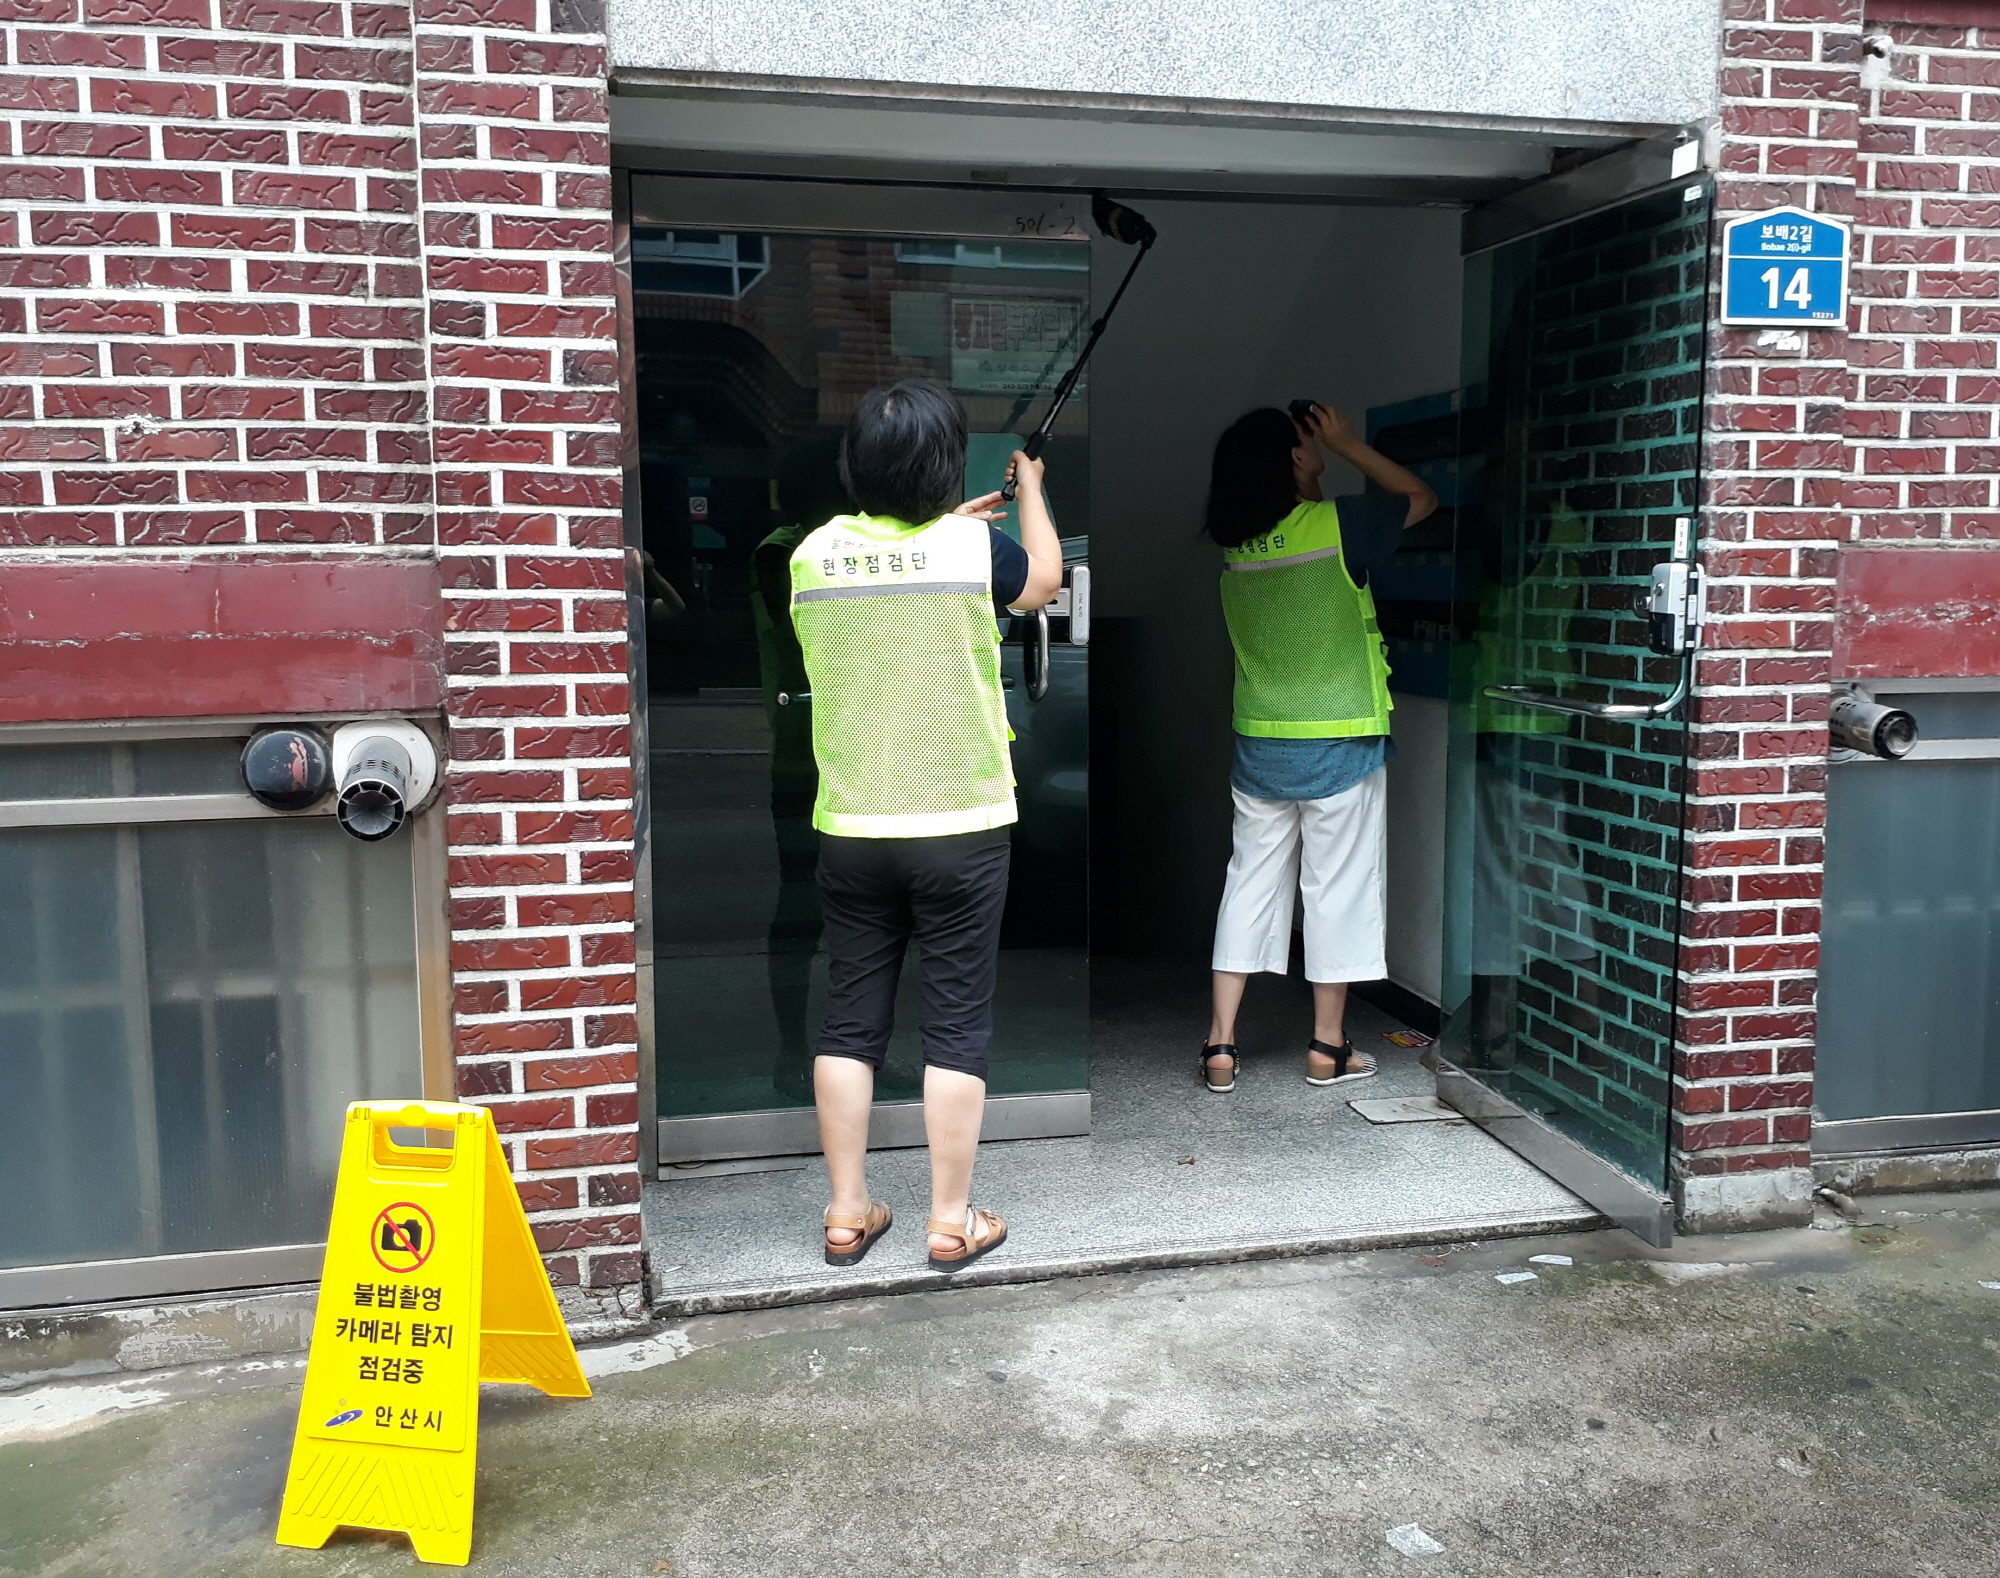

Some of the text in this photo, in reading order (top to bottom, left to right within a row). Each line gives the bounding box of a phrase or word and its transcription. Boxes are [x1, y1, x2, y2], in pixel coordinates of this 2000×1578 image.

[1760, 224, 1813, 243] 보배2길
[1761, 242, 1786, 252] Bobae
[1760, 267, 1812, 310] 14
[1811, 311, 1835, 320] 15271
[822, 551, 927, 576] 현장점검단
[353, 1282, 442, 1312] 불법촬영
[336, 1317, 454, 1350] 카메라 탐지
[358, 1355, 425, 1385] 점검중
